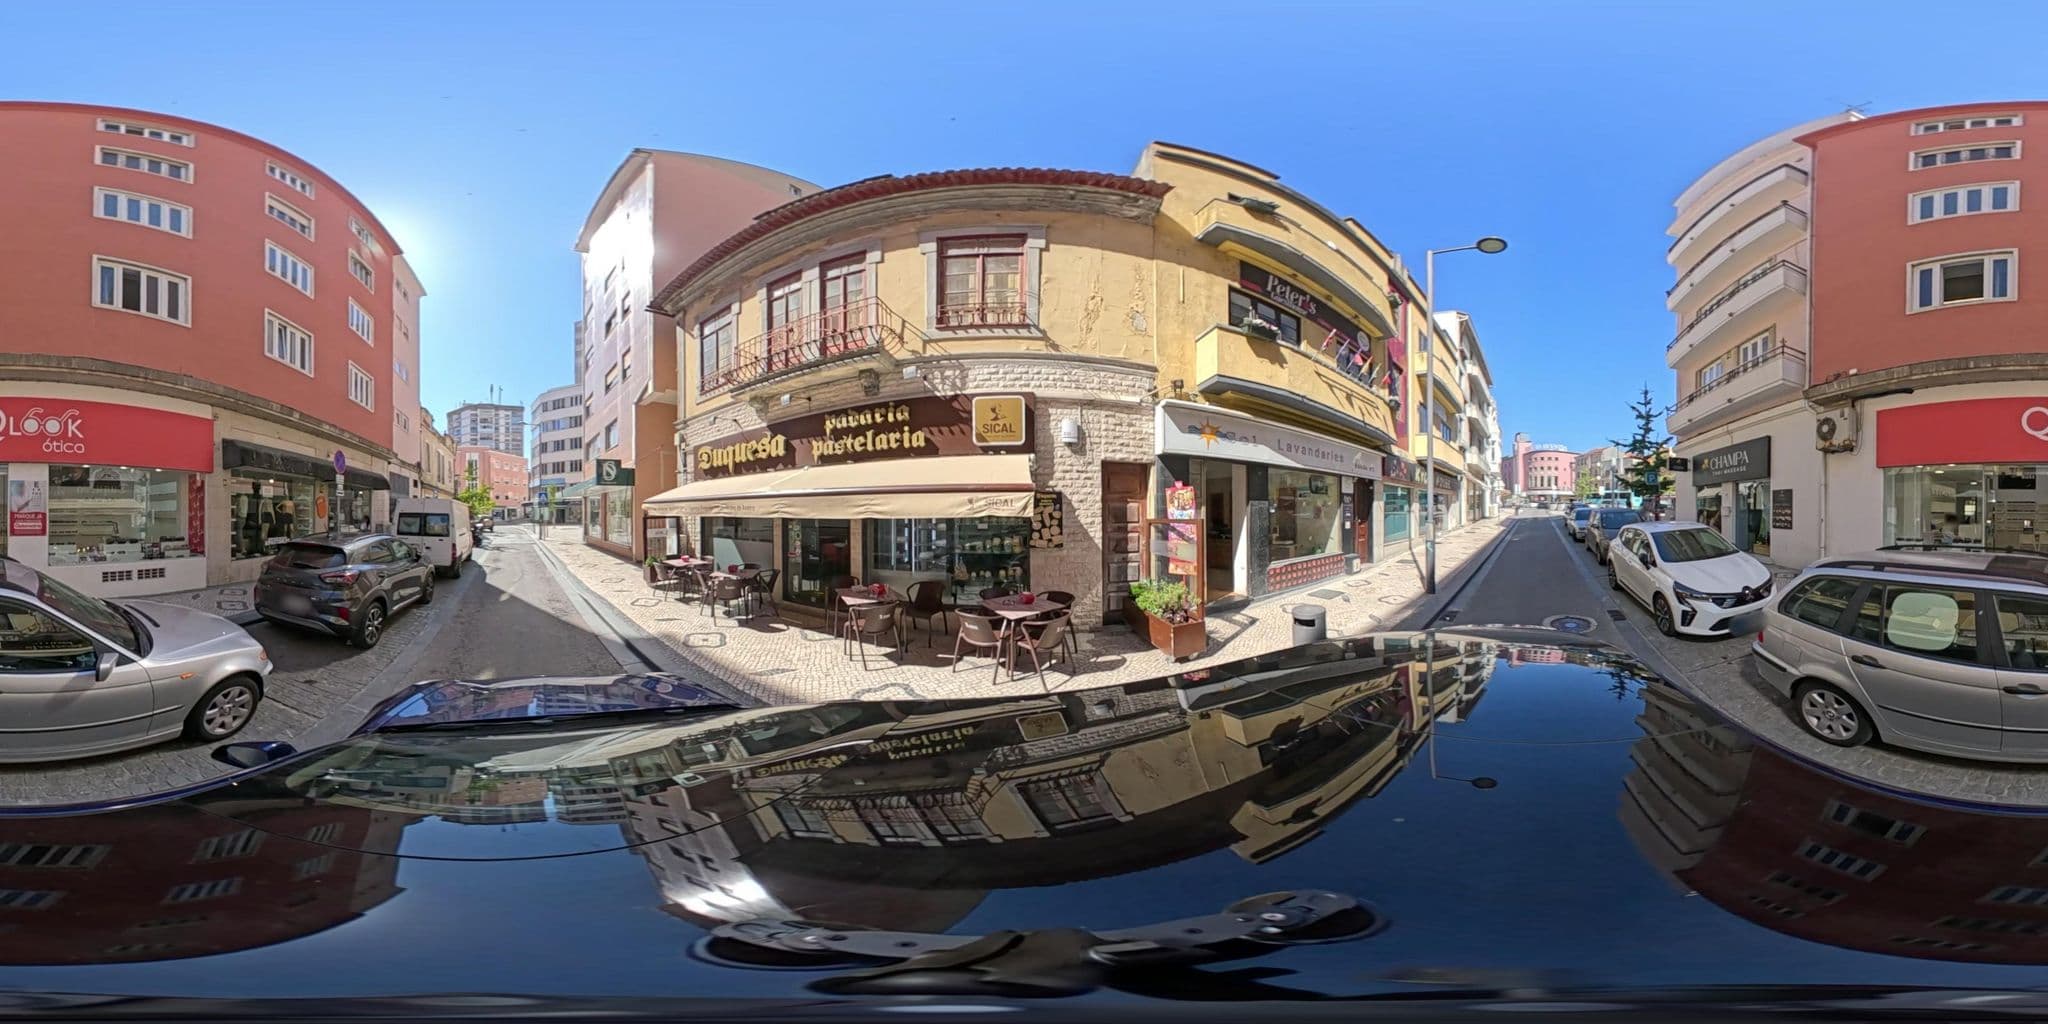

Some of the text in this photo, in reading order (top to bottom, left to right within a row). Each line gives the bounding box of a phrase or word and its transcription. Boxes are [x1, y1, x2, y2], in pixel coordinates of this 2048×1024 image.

[1266, 275, 1317, 315] Peter's
[982, 423, 1016, 434] SICAL
[42, 438, 85, 454] ótica
[698, 432, 787, 476] Duquesa
[812, 426, 927, 464] pastelaria
[1710, 450, 1749, 470] CHAMPA
[985, 498, 1016, 508] SICAL
